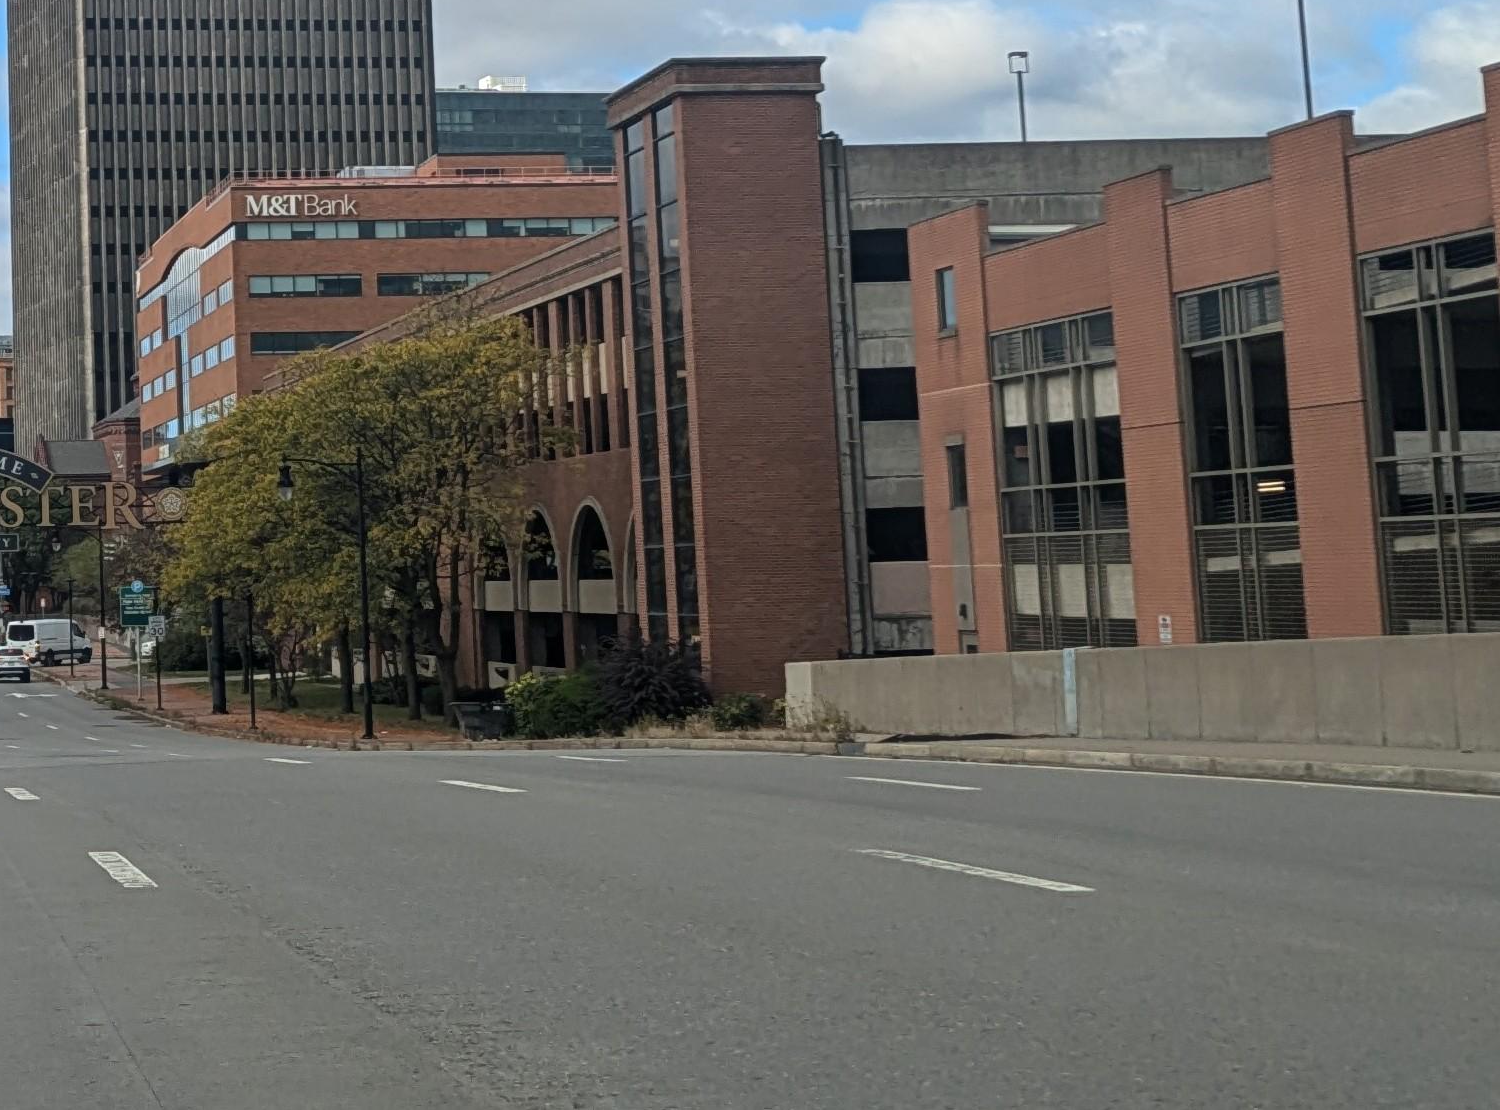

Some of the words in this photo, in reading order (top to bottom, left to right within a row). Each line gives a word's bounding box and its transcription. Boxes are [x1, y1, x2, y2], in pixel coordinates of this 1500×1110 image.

[244, 194, 302, 216] M&T
[304, 193, 358, 216] Bank
[150, 627, 164, 636] 30
